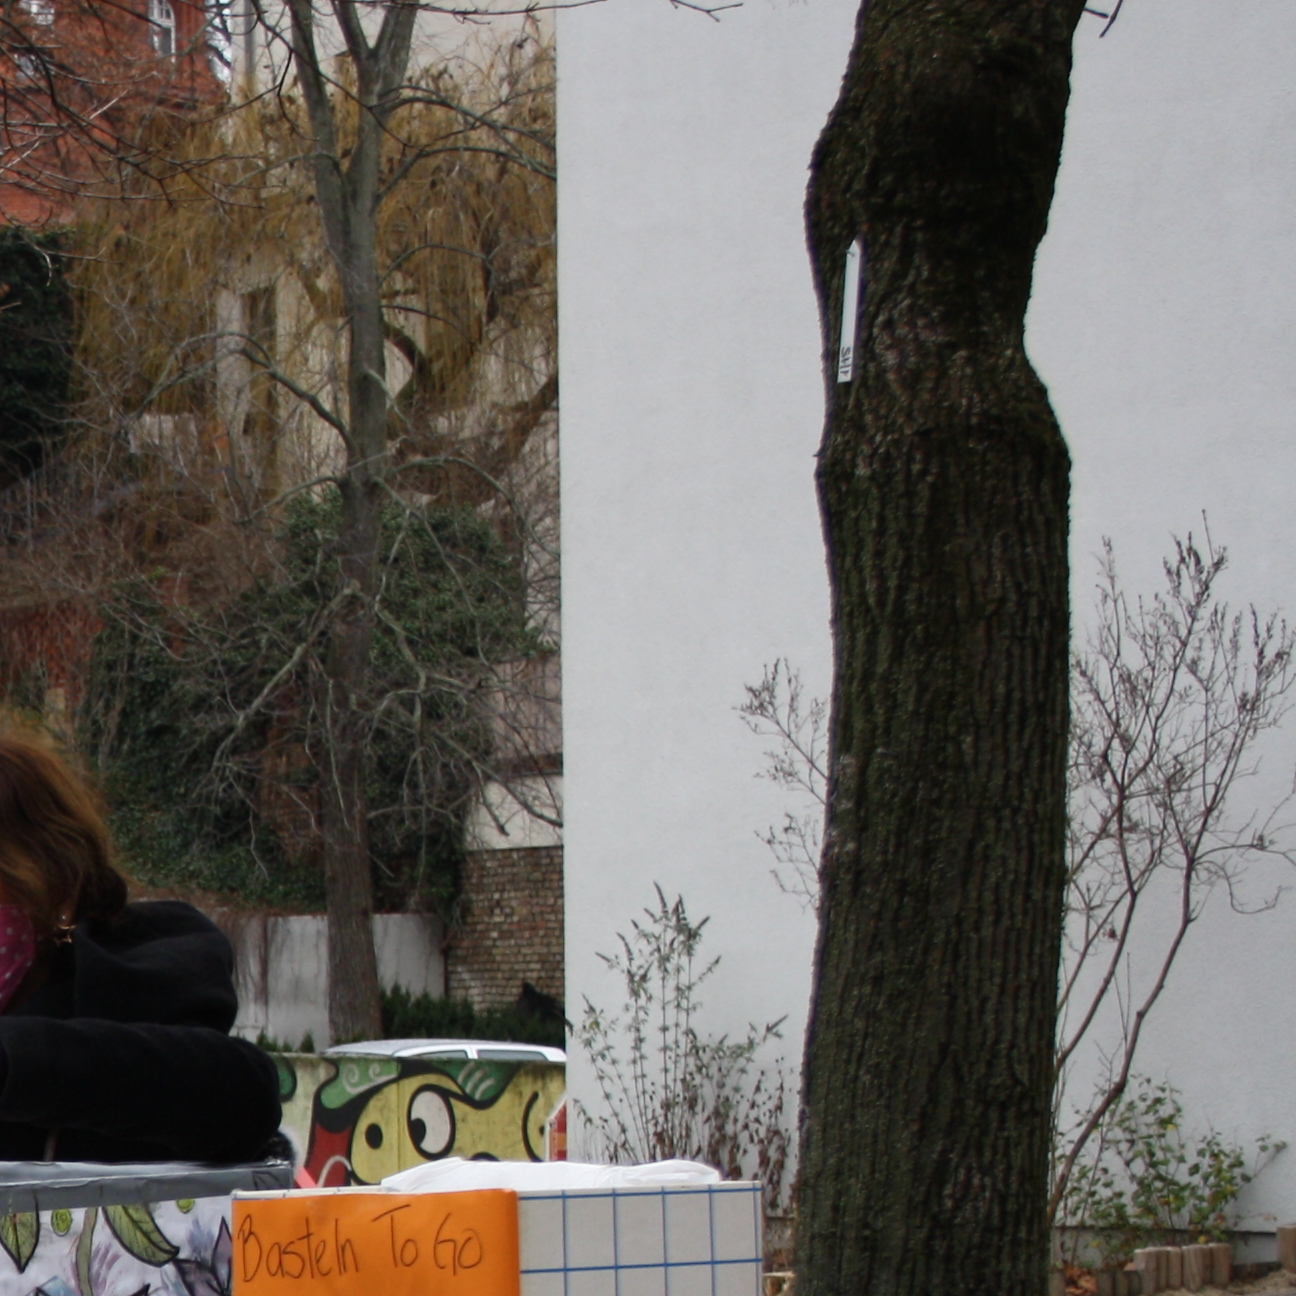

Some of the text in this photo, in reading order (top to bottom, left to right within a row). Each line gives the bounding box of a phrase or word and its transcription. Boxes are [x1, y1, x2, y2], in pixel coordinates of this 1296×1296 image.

[237, 1203, 484, 1284] Basteln To Go
